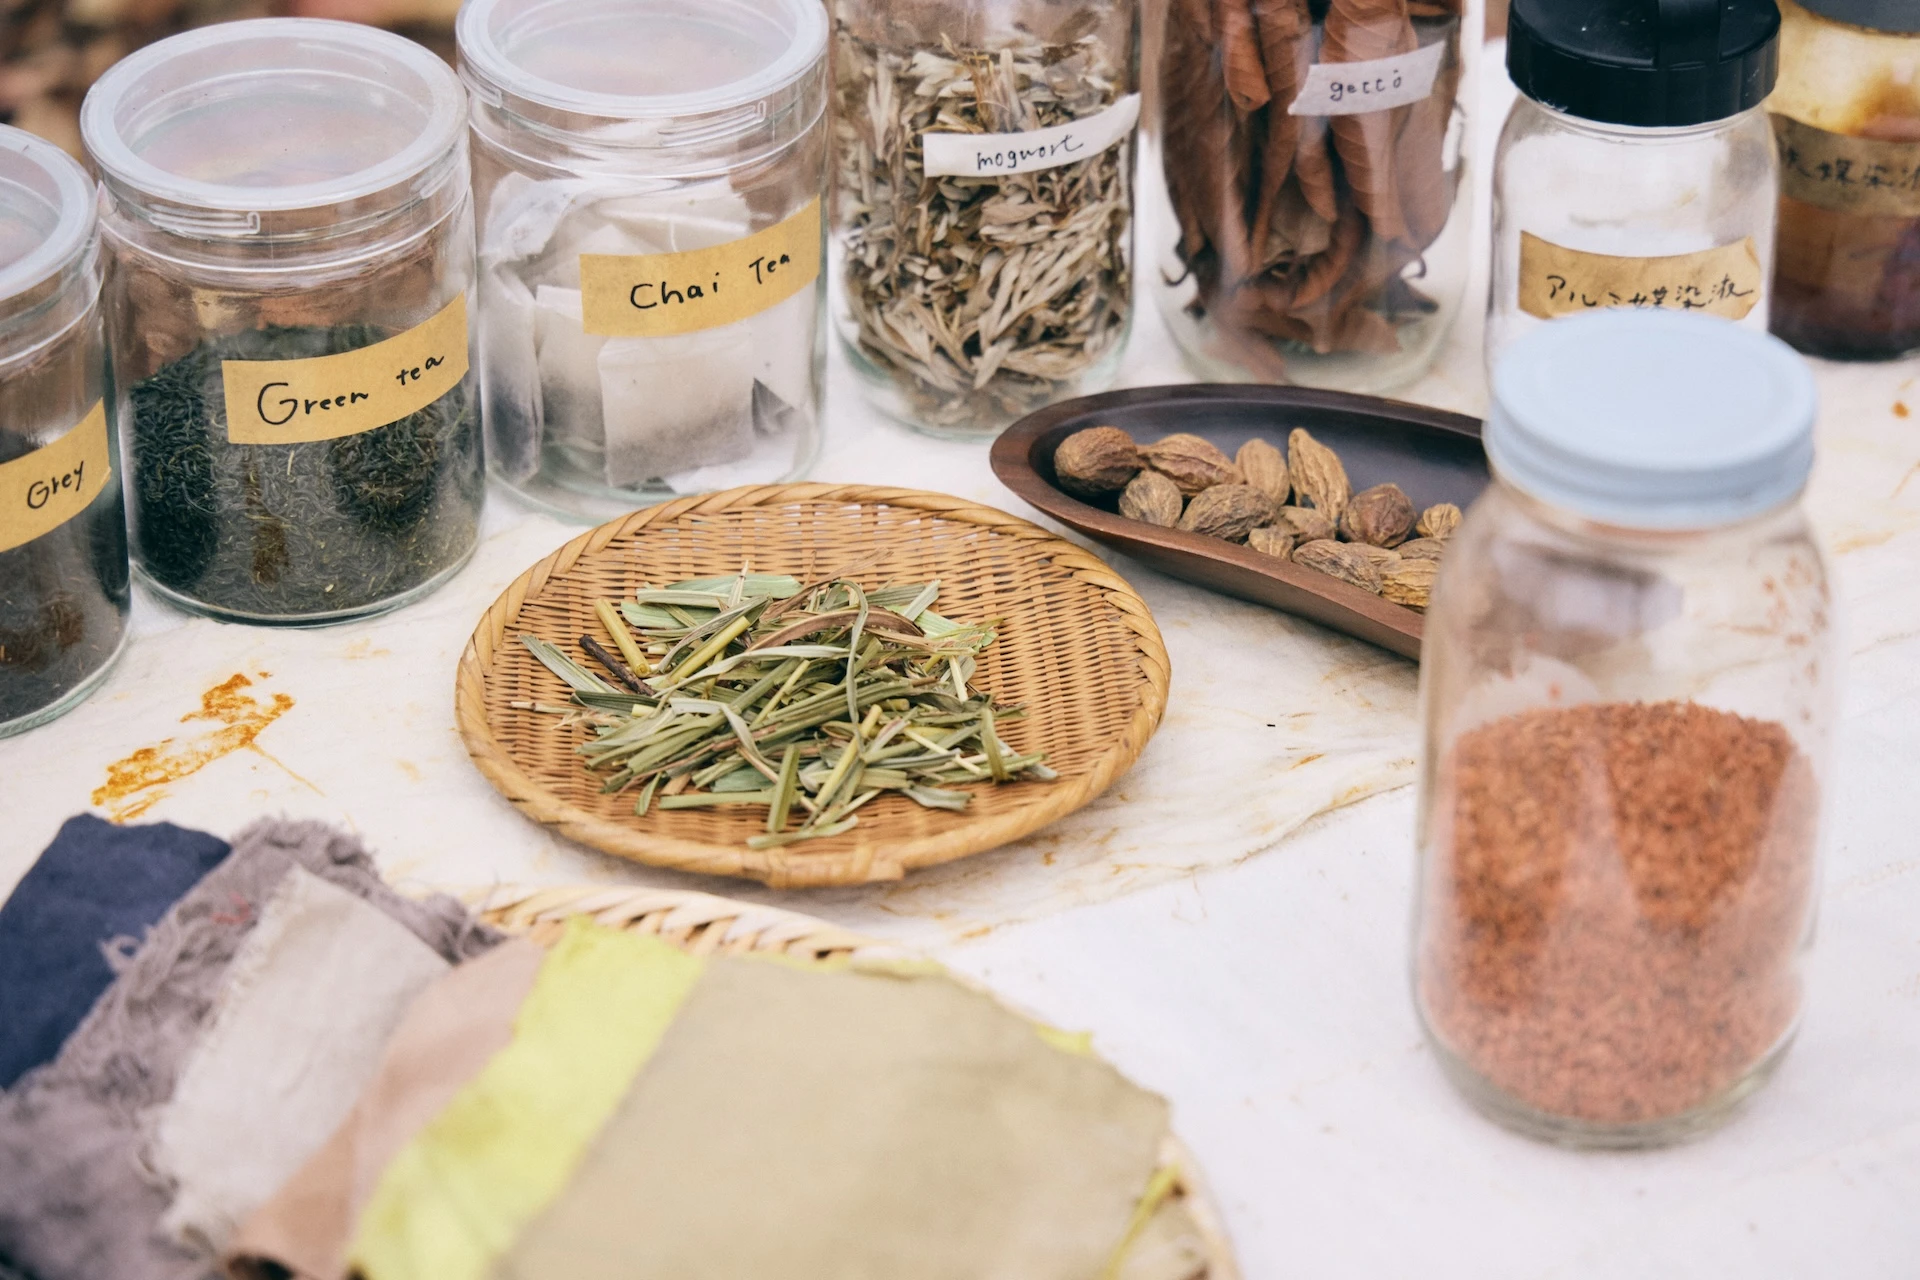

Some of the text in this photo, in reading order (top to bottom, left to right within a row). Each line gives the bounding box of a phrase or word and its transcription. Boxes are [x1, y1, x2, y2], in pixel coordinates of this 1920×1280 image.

[630, 254, 791, 309] Chai Tea
[257, 356, 445, 426] Green tea
[27, 460, 84, 510] Grey
